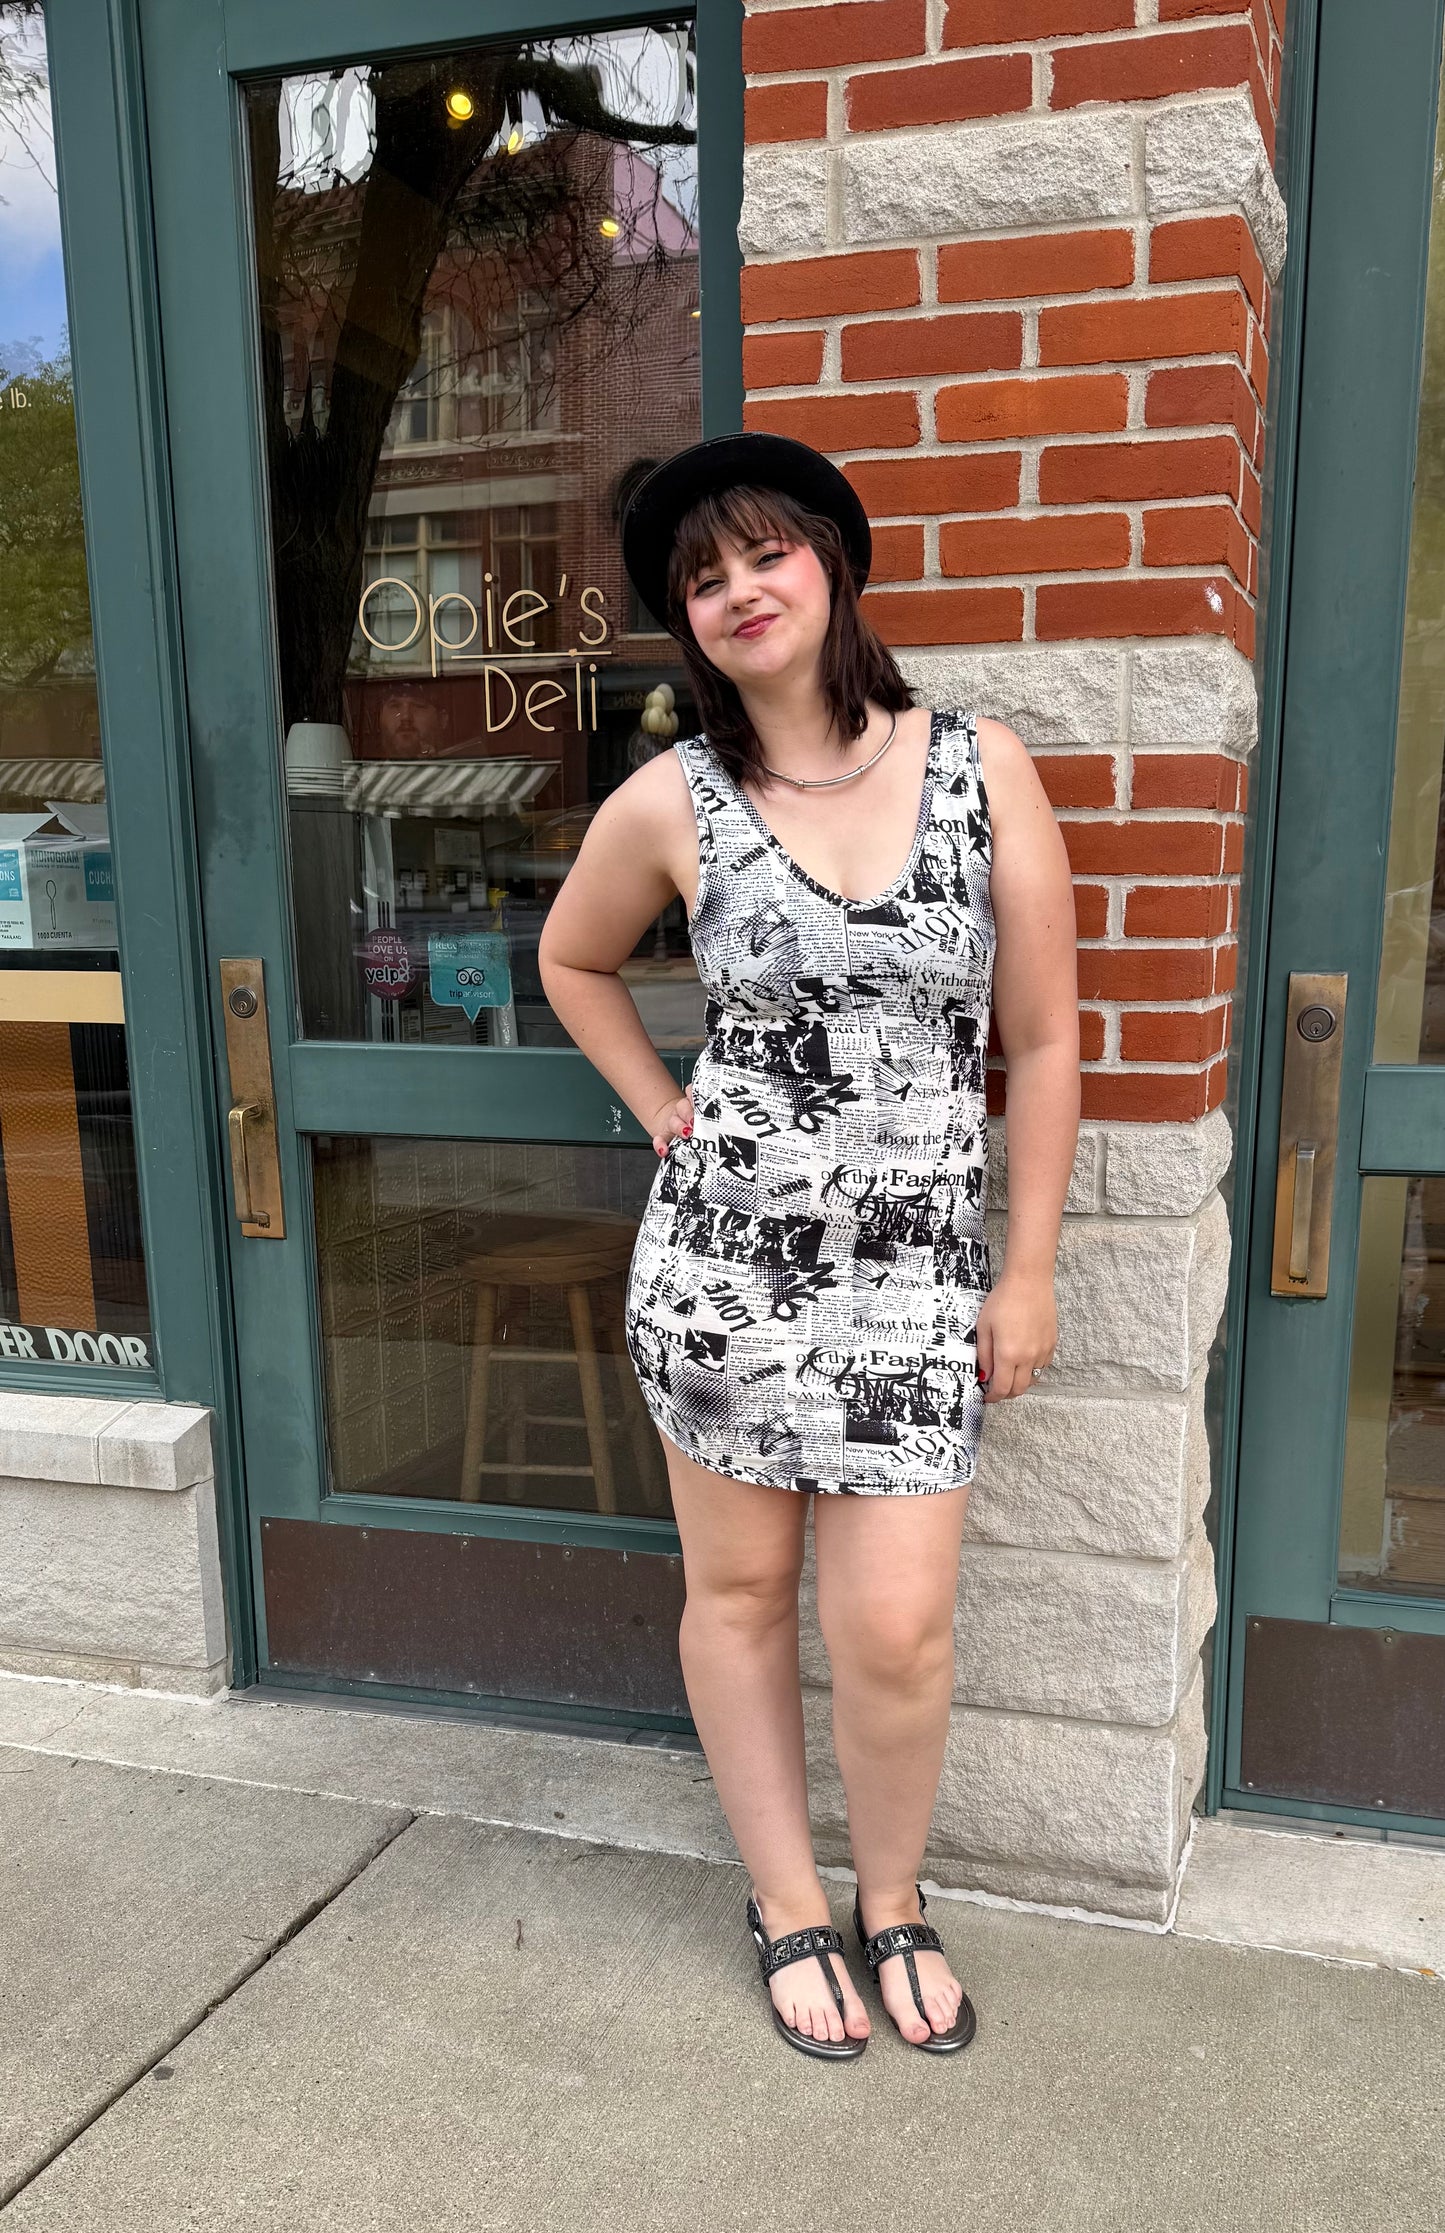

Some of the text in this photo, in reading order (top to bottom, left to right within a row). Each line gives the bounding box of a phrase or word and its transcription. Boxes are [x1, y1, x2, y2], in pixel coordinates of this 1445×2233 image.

[10, 387, 32, 409] lb.
[359, 572, 608, 678] Opie's
[484, 662, 597, 732] Deli
[30, 850, 80, 864] MONOGRAM
[88, 870, 113, 885] CUCH
[50, 931, 73, 939] CUENTA
[849, 930, 870, 938] New
[888, 905, 964, 955] LOVE
[395, 945, 409, 955] US
[366, 964, 399, 986] yelp
[913, 1088, 949, 1098] NEWS
[721, 1085, 781, 1138] LOVE
[922, 1130, 942, 1145] the
[889, 1168, 965, 1188] Fashion
[890, 1277, 933, 1291] NEWS
[702, 1280, 757, 1332] LOVE
[901, 1317, 928, 1331] the
[45, 1328, 151, 1367] DOOR
[870, 1350, 974, 1374] Fashion
[787, 1390, 842, 1401] NEWS
[845, 1446, 881, 1455] New York
[881, 1429, 953, 1467] LOVE
